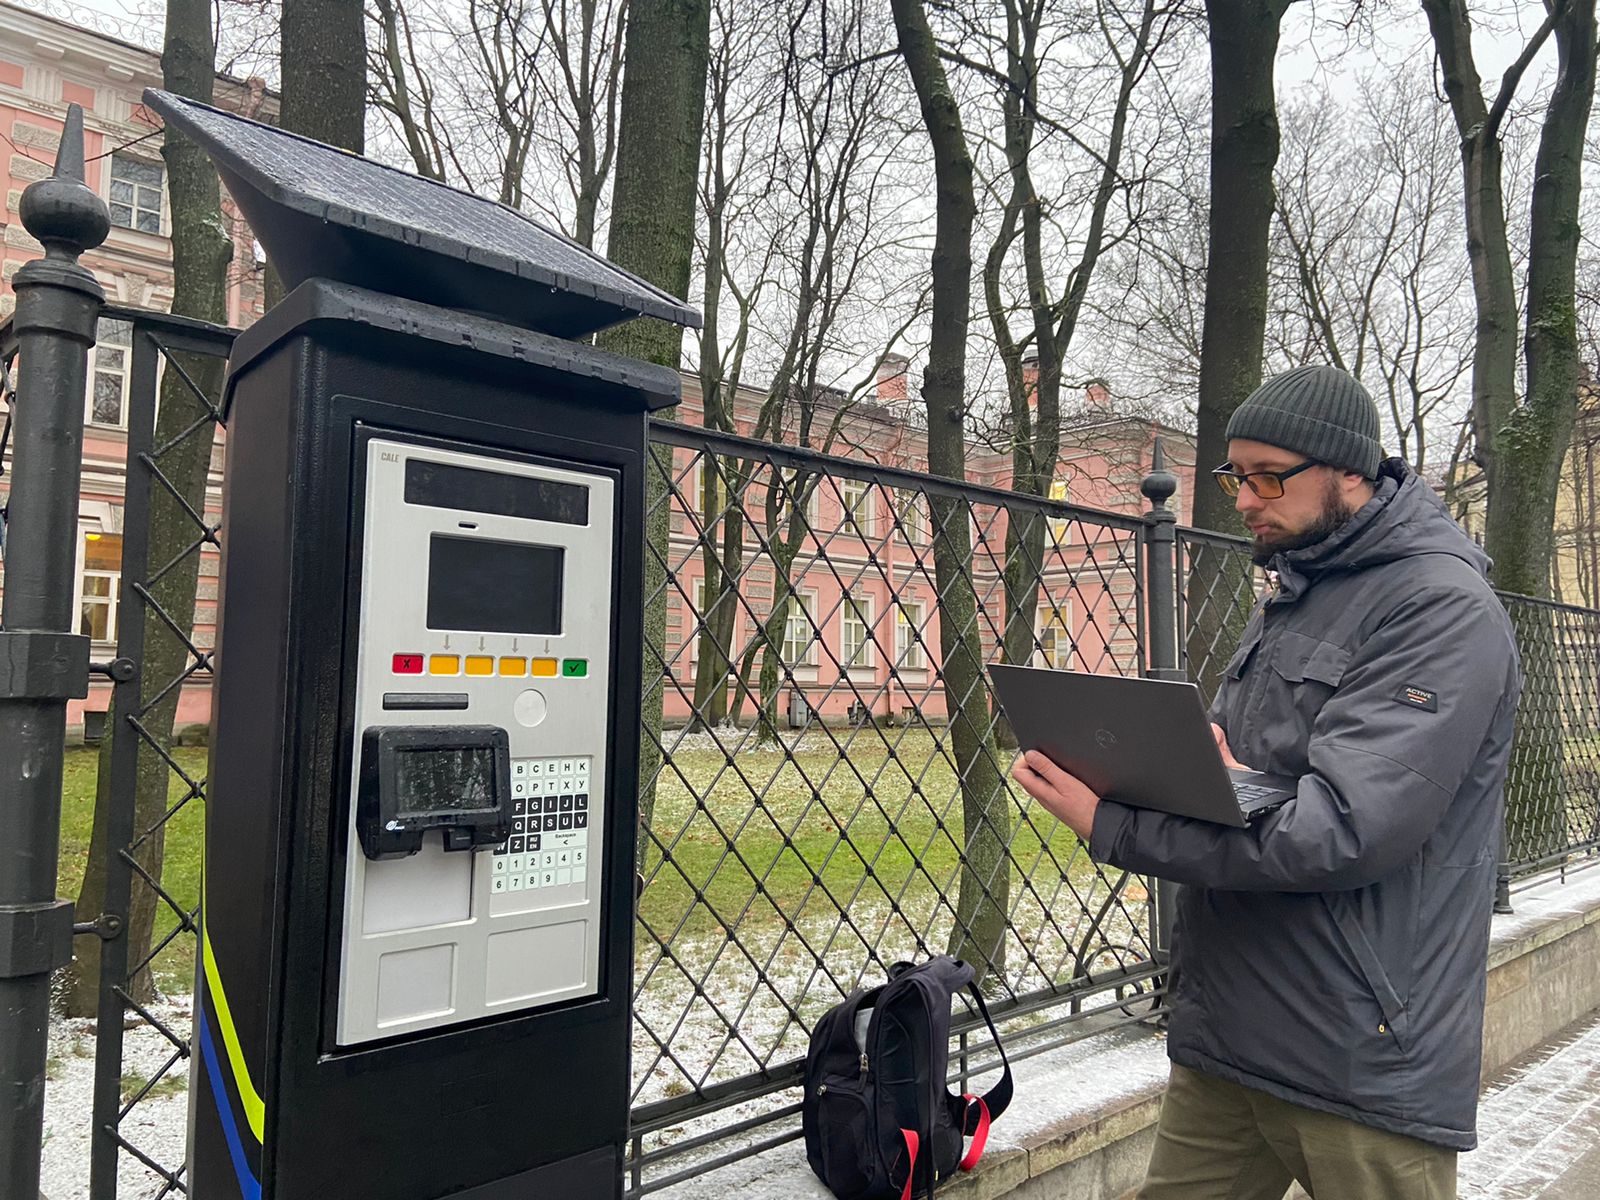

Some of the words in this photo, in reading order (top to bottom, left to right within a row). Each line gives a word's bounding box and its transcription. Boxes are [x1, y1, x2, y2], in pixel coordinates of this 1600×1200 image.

[380, 452, 400, 463] CALE
[1406, 687, 1432, 699] ACTIVE
[517, 765, 523, 774] B
[533, 764, 539, 773] C
[549, 764, 555, 772] E
[564, 763, 570, 771] H
[579, 762, 586, 771] K
[516, 784, 523, 793] O
[533, 783, 539, 792] P
[548, 782, 555, 790] T
[564, 781, 570, 789] X
[515, 803, 522, 811] F
[531, 801, 538, 810] G
[549, 800, 553, 809] I
[563, 799, 569, 808] J
[579, 798, 584, 807] L
[514, 821, 522, 831] Q
[531, 820, 538, 829] R
[547, 818, 553, 827] S
[563, 817, 569, 826] U
[578, 816, 584, 824] V
[514, 840, 521, 849] Z
[497, 861, 503, 870] 0
[514, 859, 518, 868] 1
[530, 857, 536, 866] 2
[546, 855, 552, 864] 3
[561, 854, 566, 862] 4
[577, 852, 582, 860] 5
[496, 880, 502, 889] 6
[513, 878, 519, 886] 7
[529, 876, 535, 884] 8
[545, 874, 551, 882] 9
